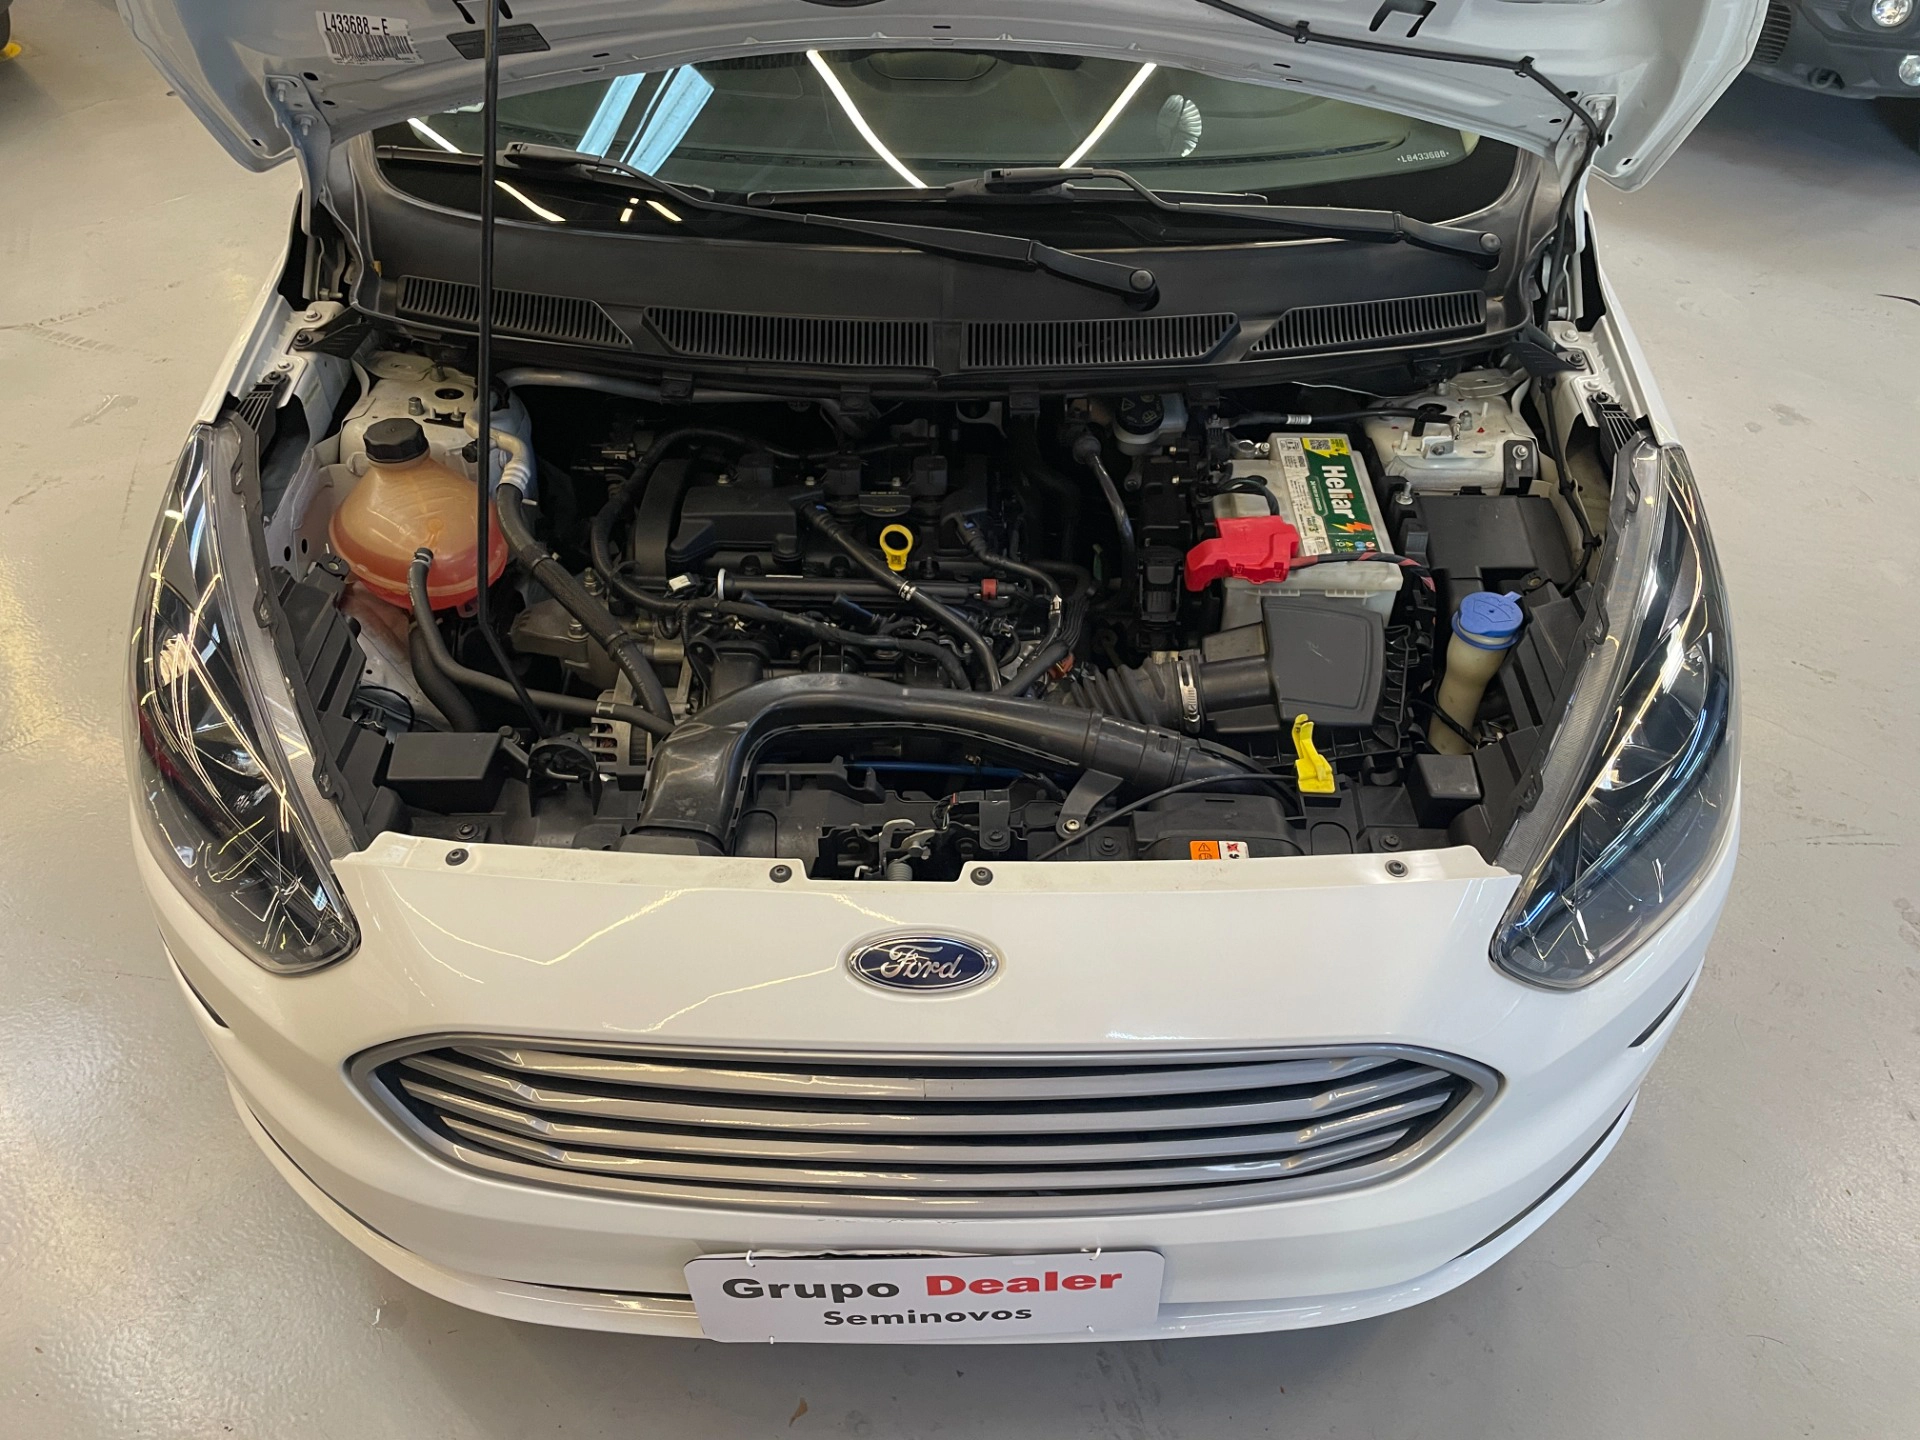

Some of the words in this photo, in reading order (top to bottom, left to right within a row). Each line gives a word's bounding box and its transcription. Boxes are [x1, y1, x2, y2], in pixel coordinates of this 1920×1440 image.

[1321, 465, 1355, 519] Heliar
[881, 944, 964, 979] Ford
[722, 1278, 900, 1303] Grupo
[926, 1271, 1123, 1296] Dealer
[823, 1308, 1033, 1326] Seminovos
